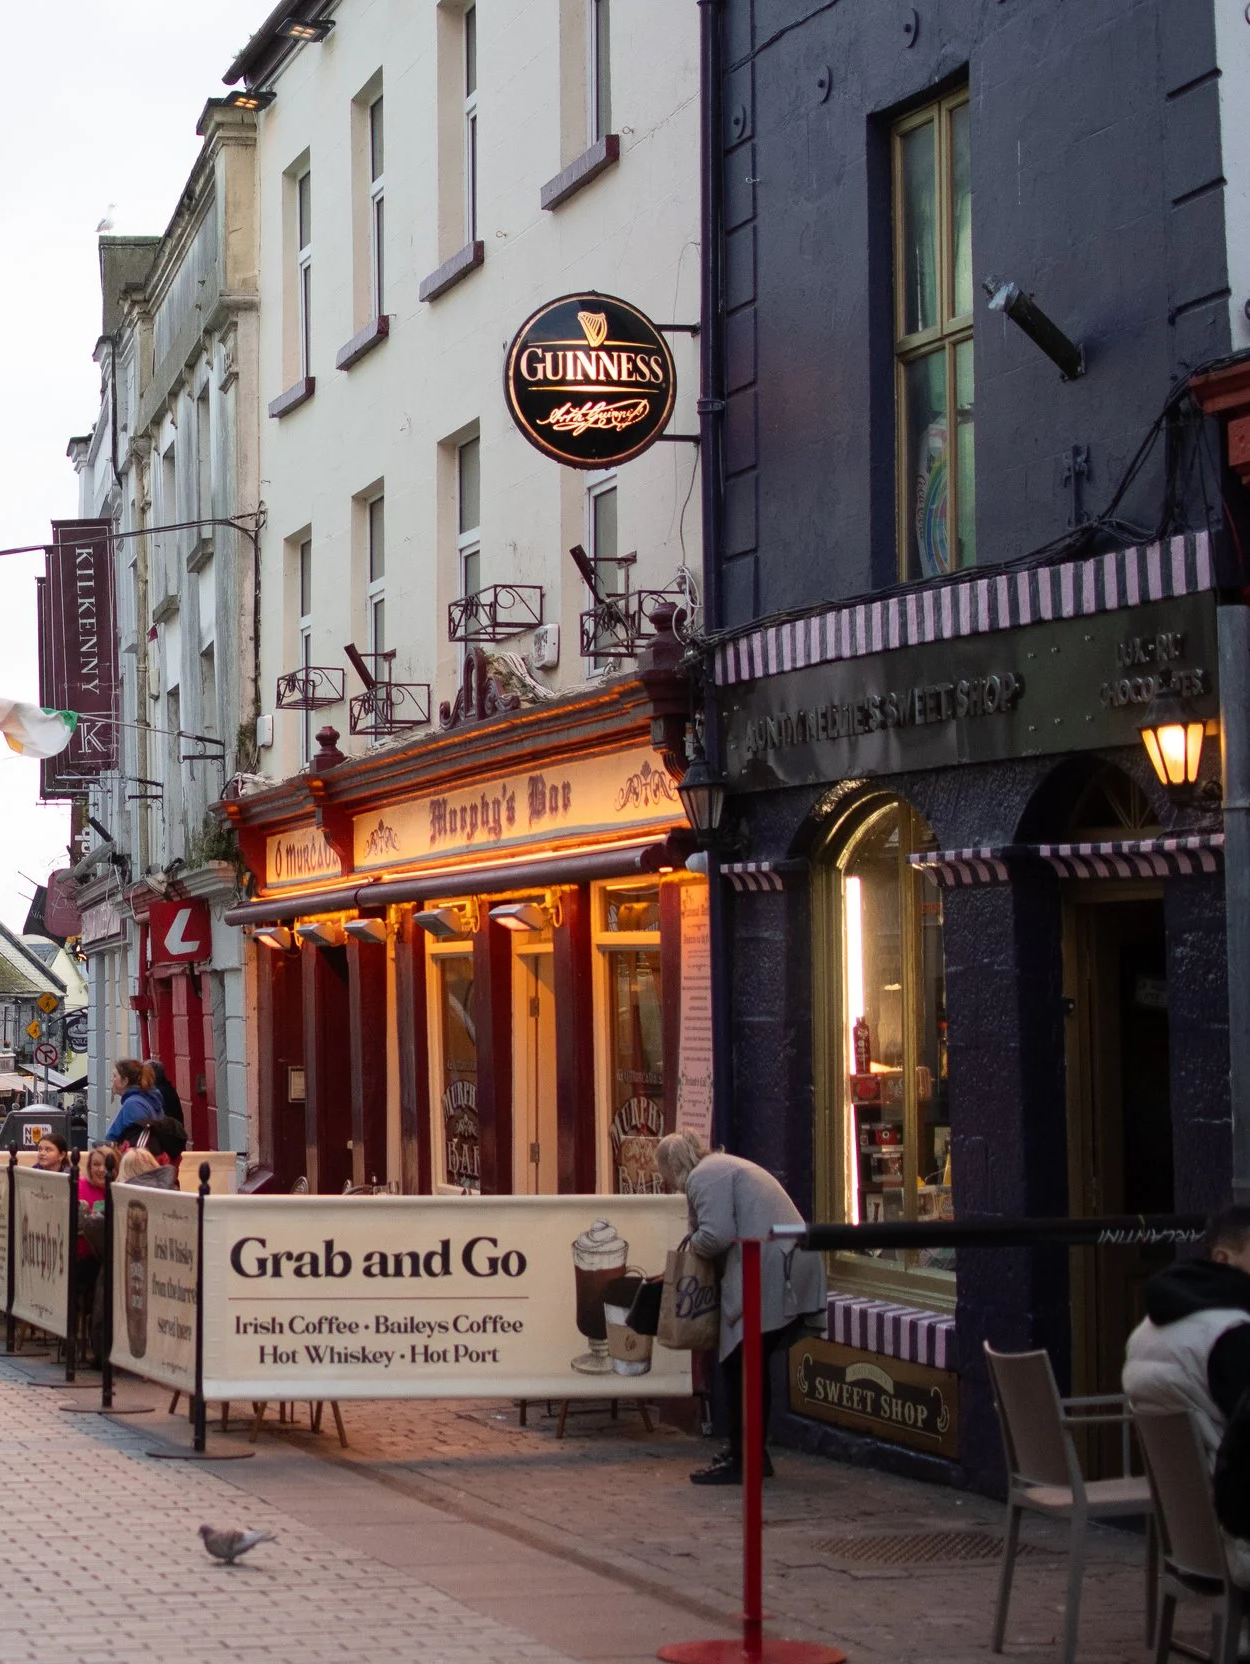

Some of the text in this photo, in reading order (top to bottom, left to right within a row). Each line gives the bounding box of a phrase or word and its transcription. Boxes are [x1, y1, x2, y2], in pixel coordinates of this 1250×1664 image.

[520, 347, 663, 383] GUINNESS
[75, 546, 100, 695] KILKENNY
[954, 671, 1018, 718] SHOP
[229, 1235, 527, 1279] Grab and Go
[234, 1314, 524, 1340] Irish Coffee Baileys Coffee
[258, 1344, 501, 1368] Hot Whiskey Hot Port
[814, 1375, 875, 1413] SWEET
[880, 1394, 928, 1428] SHOP
